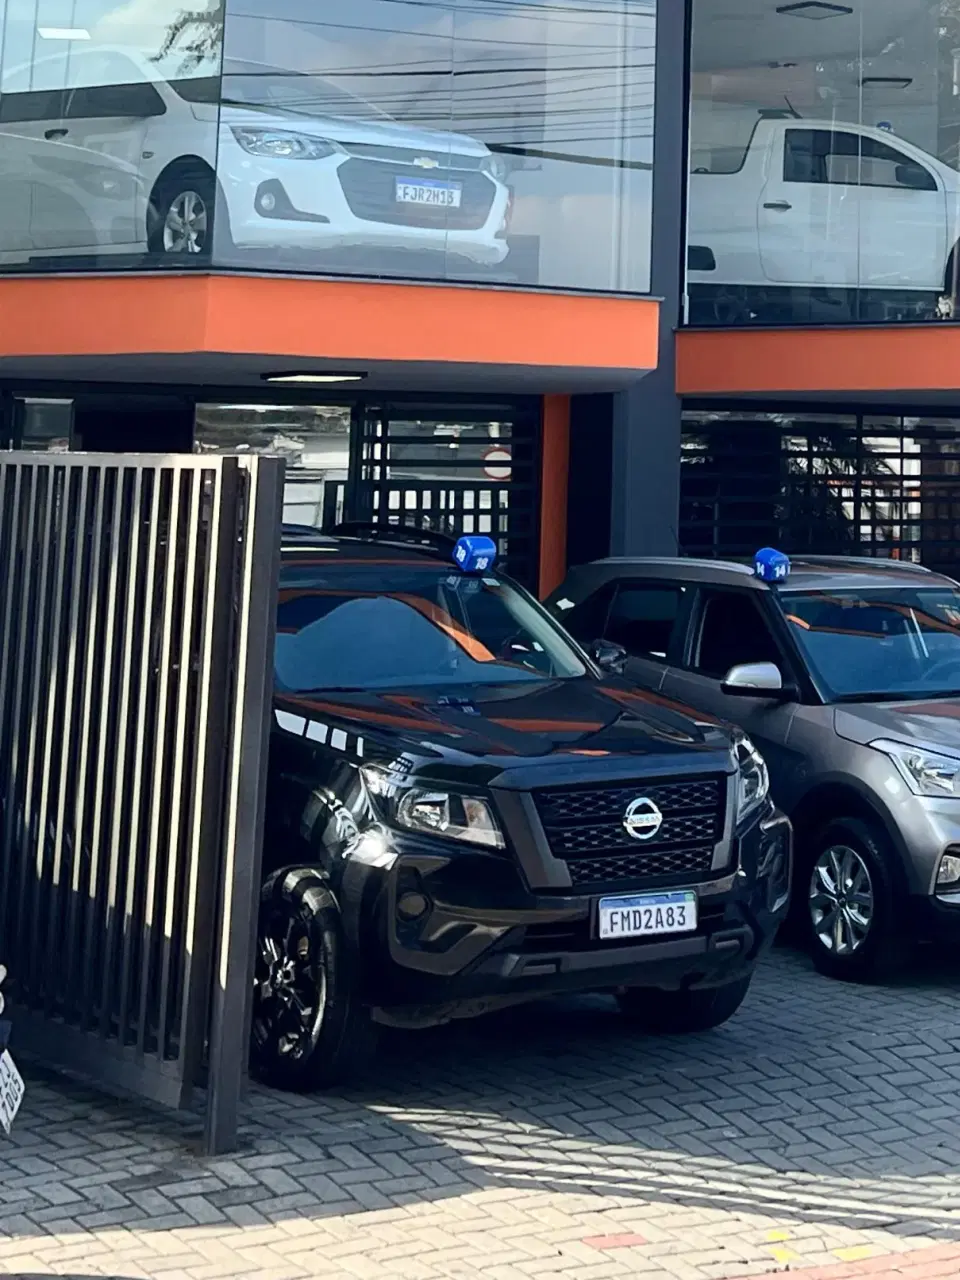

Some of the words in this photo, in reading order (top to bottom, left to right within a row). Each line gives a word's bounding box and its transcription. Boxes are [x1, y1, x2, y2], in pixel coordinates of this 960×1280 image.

[475, 557, 489, 570] 18
[774, 564, 786, 578] 14
[609, 905, 687, 934] FMD2A83
